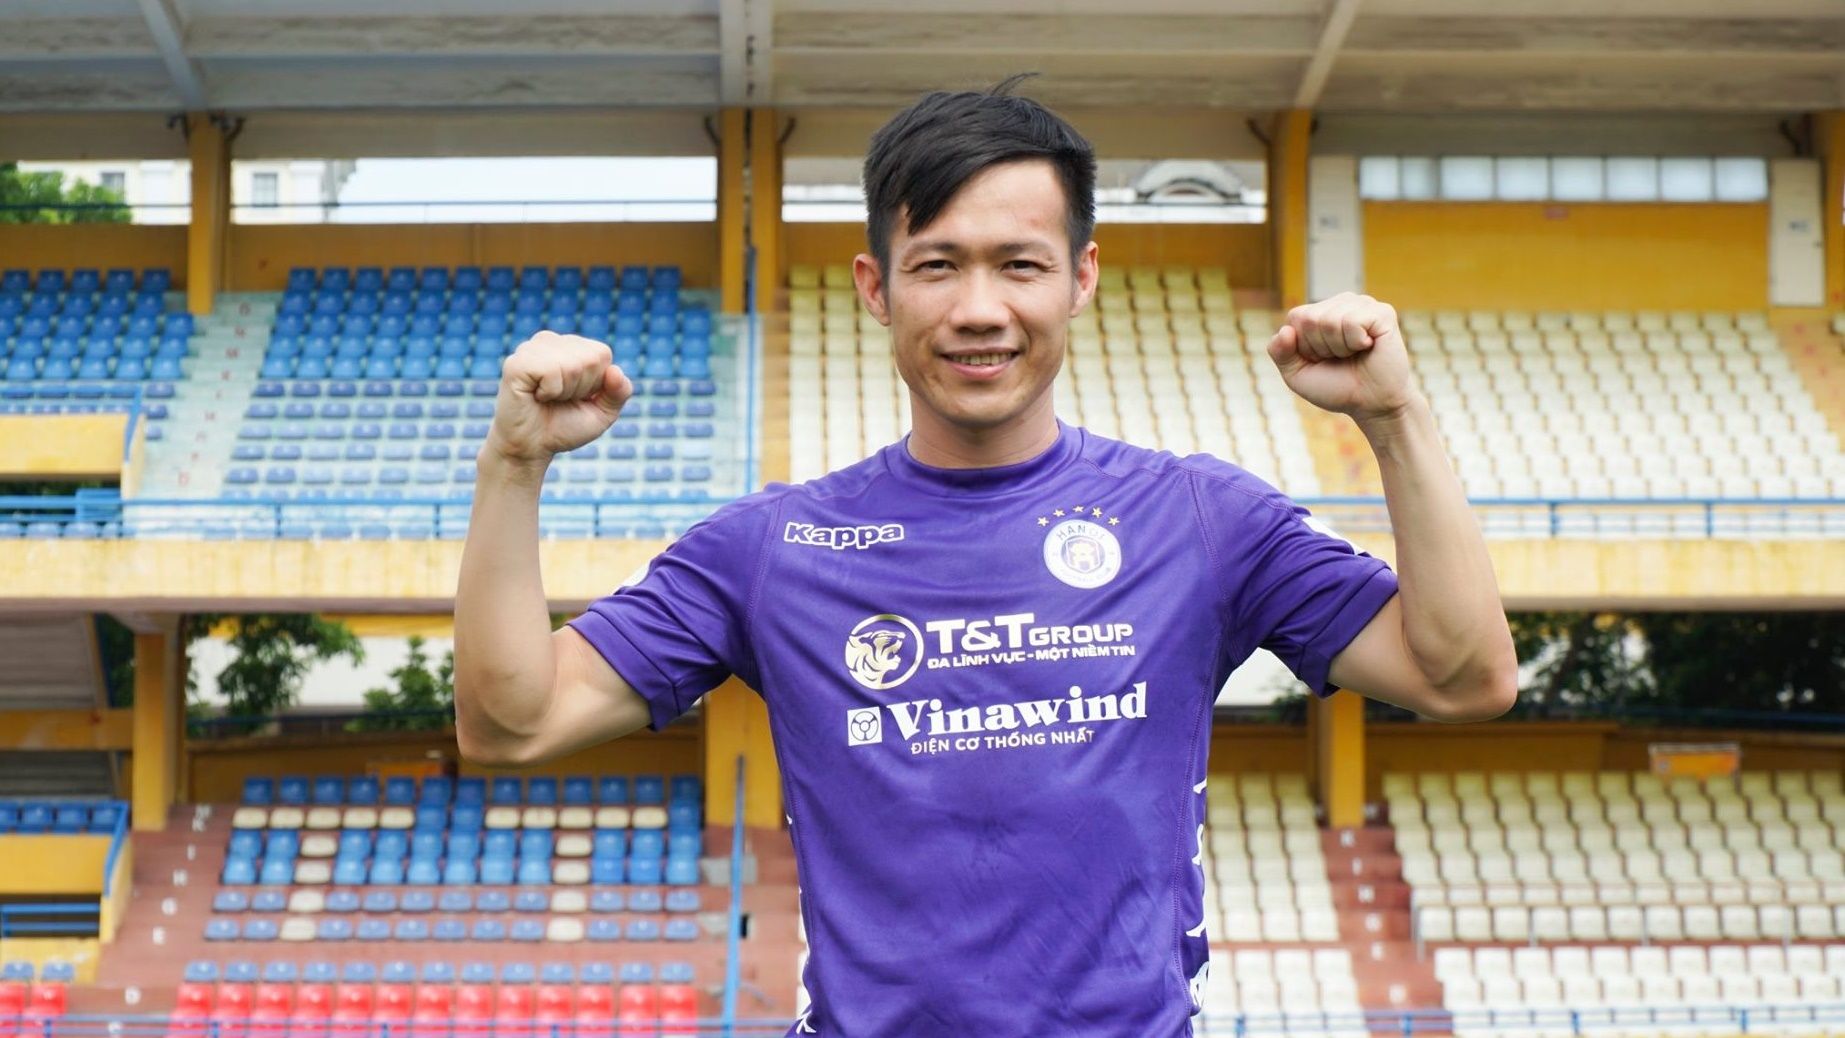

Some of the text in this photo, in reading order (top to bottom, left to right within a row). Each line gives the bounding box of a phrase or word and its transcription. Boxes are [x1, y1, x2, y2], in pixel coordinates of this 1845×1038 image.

[784, 521, 905, 550] Kappa
[926, 612, 1134, 654] T&T GROUP
[1035, 646, 1070, 661] MỘT
[1110, 645, 1136, 656] TIN
[886, 681, 1148, 741] Vinawind
[911, 726, 1095, 755] ĐIỆN CƠ THỐNG NHẤT
